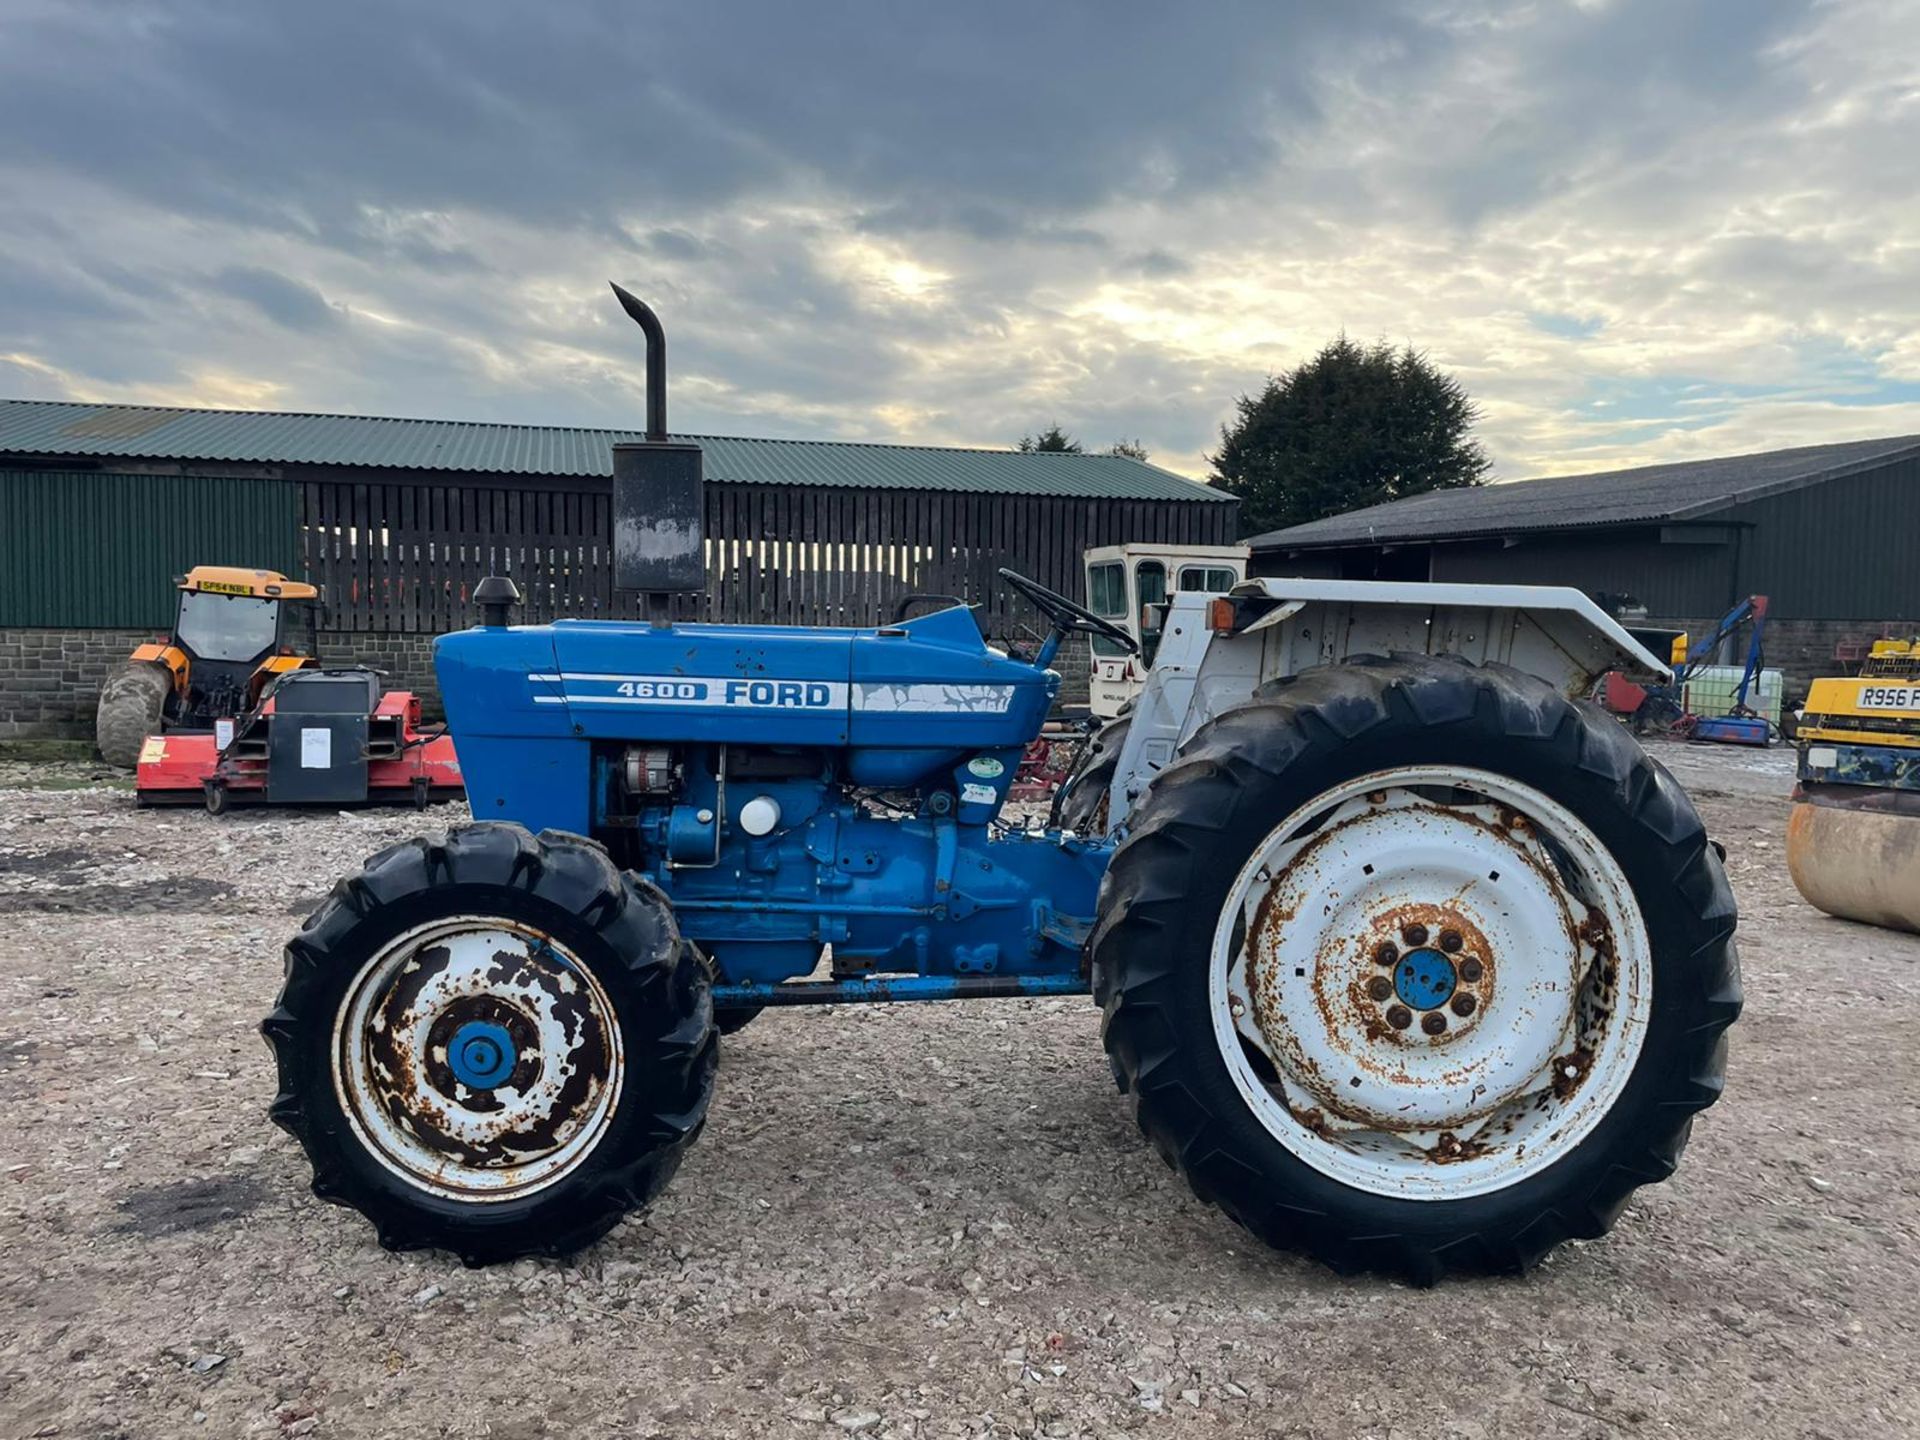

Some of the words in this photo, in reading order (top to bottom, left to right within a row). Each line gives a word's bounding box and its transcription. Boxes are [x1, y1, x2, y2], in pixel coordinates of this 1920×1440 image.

[617, 682, 696, 698] 4600
[726, 682, 830, 706] FORD
[1863, 689, 1907, 706] R956
